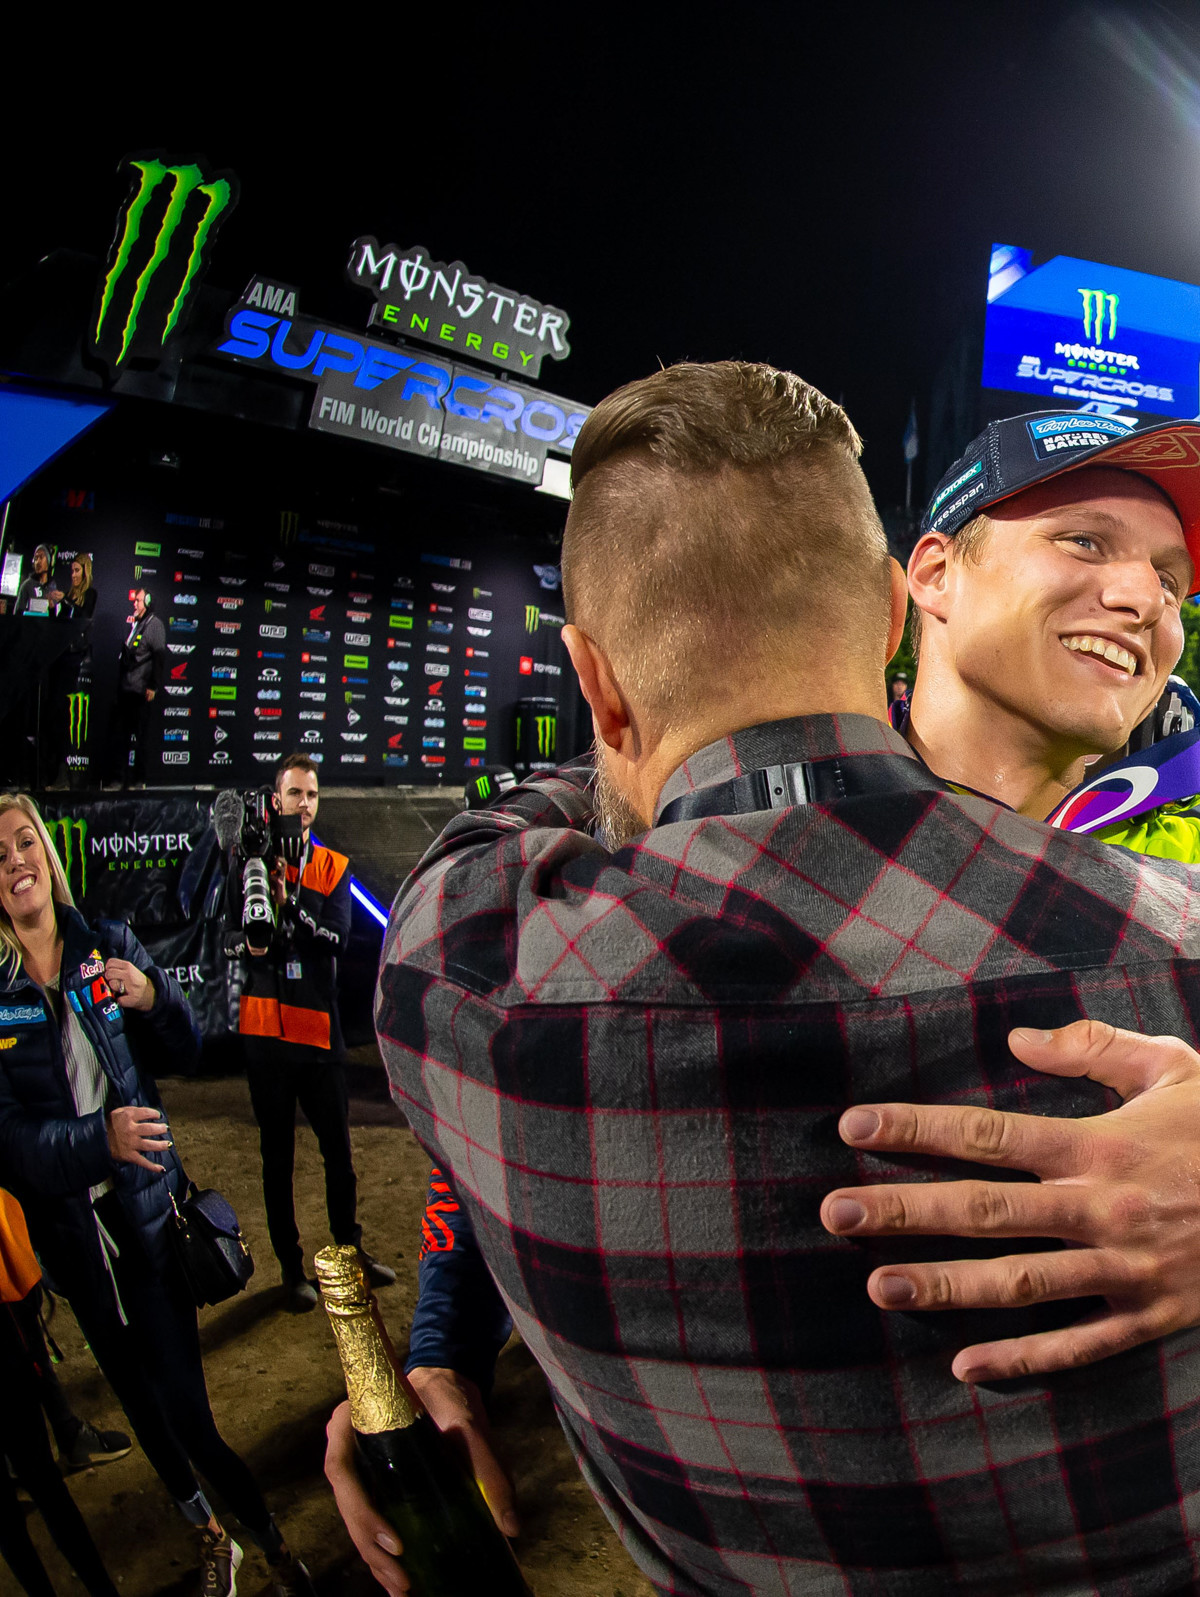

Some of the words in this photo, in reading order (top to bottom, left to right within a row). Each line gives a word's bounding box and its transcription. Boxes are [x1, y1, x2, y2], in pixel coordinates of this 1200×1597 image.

[246, 282, 296, 317] AMA
[356, 244, 564, 352] MONSTER
[383, 304, 535, 367] ENERGY
[1016, 363, 1174, 402] SUPERCROSS
[319, 396, 355, 426] FIM
[360, 406, 412, 441] World
[417, 422, 539, 477] Championship
[936, 464, 980, 504] MOTOREX
[533, 662, 562, 676] TOYOTA
[91, 831, 193, 858] MONSTER
[108, 858, 179, 872] ENERGY
